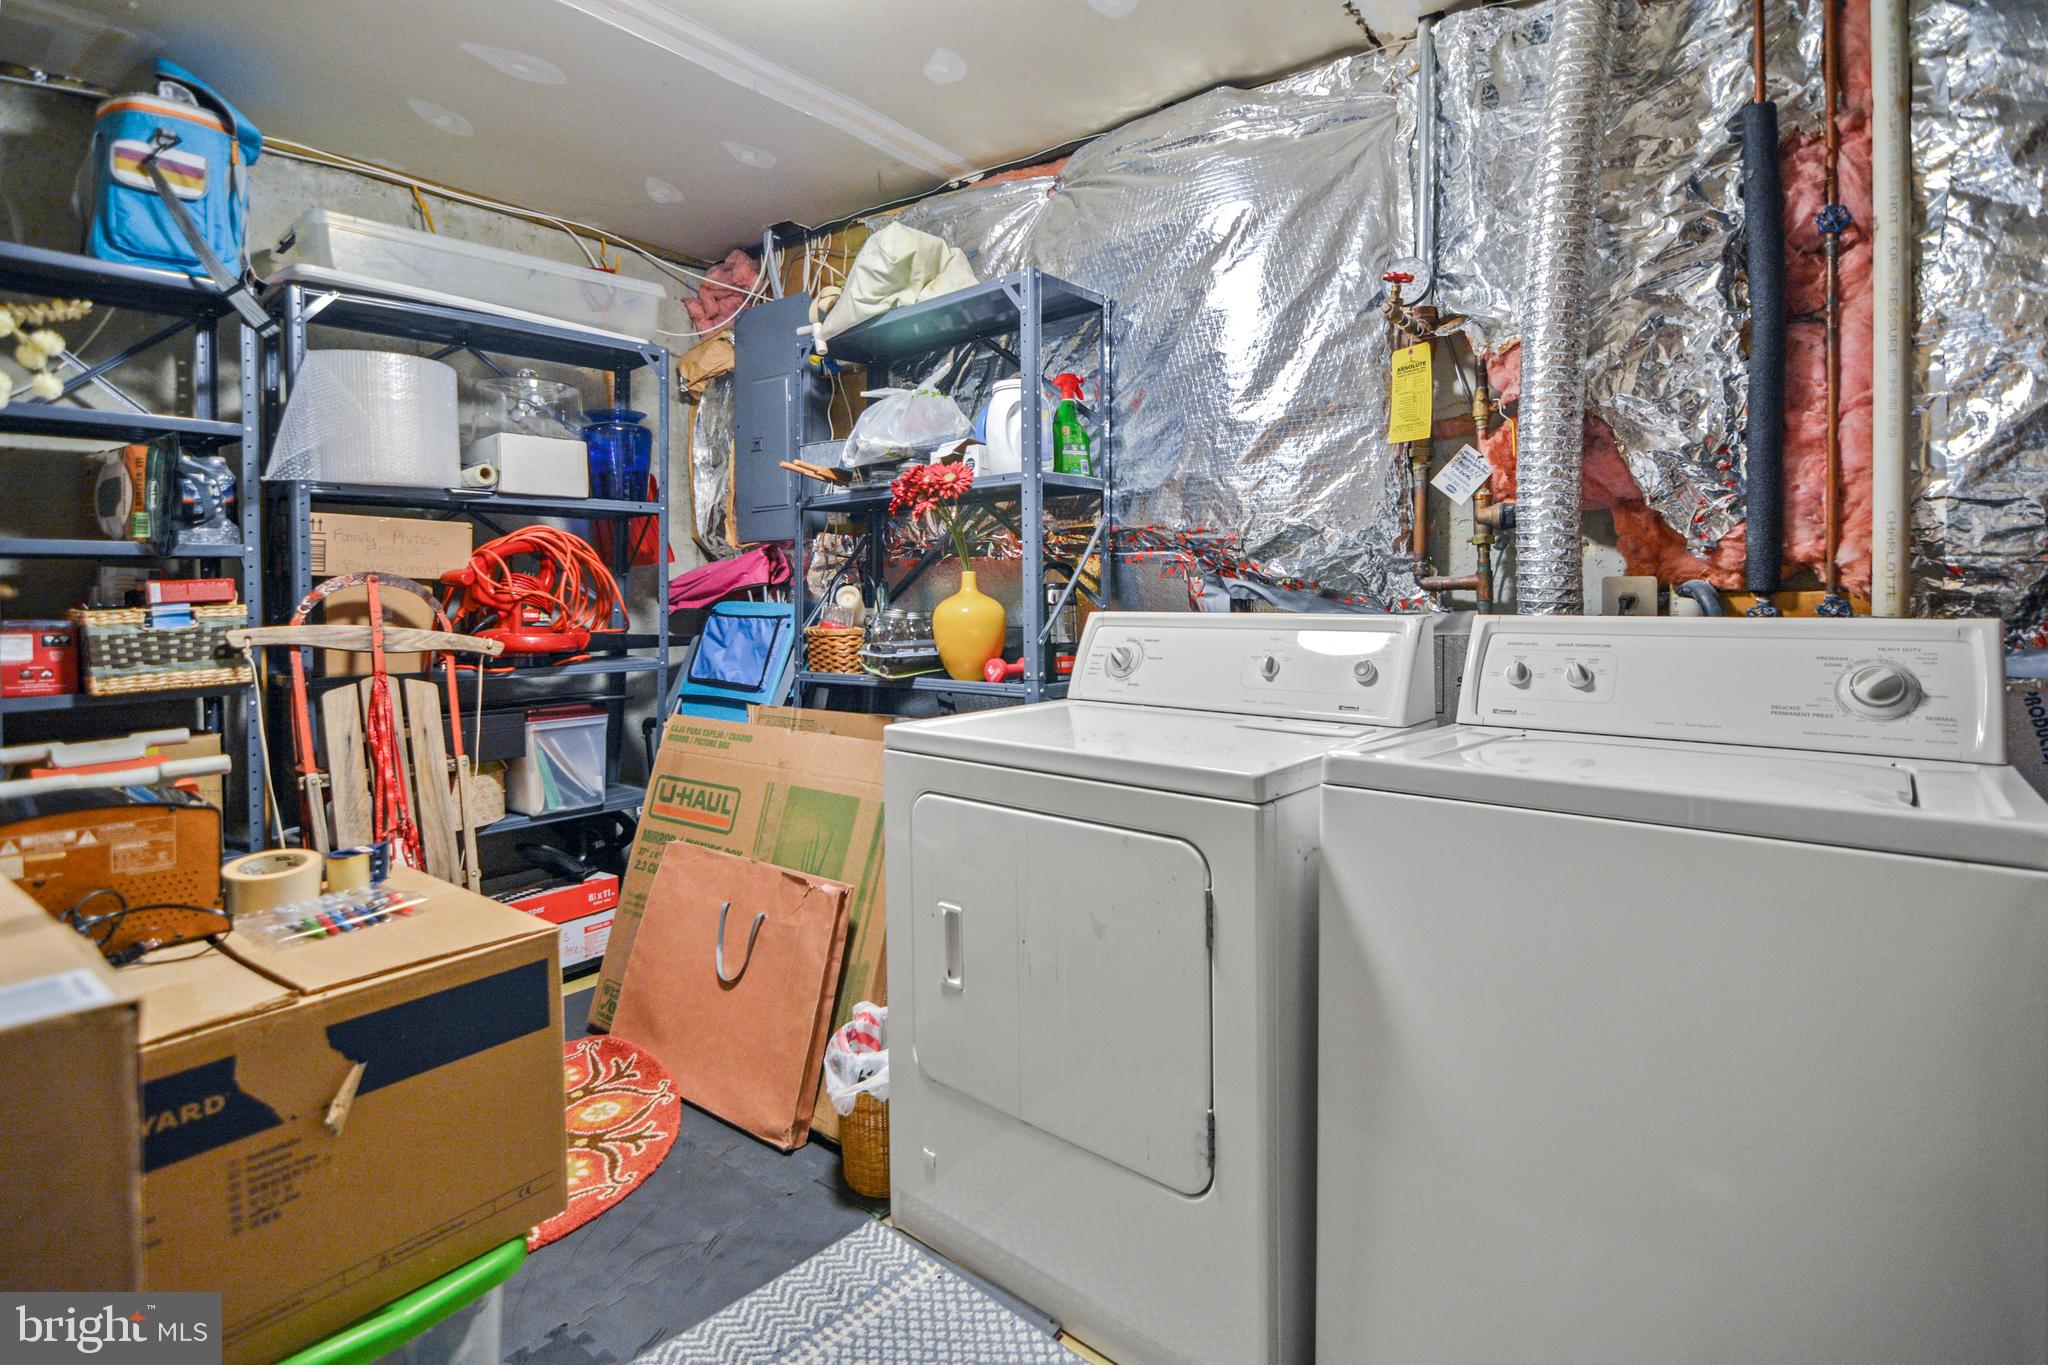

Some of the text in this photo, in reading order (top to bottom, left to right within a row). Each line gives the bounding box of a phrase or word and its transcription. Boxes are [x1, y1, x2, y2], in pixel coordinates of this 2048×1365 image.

[1888, 195, 1899, 225] NOT
[1888, 278, 1899, 358] PRESSURE
[1396, 360, 1427, 373] ABSOLUTE
[334, 529, 377, 549] Family
[1886, 510, 1897, 603] CHARLOTTE
[1770, 710, 1810, 718] PERMANENT
[658, 782, 732, 816] U-HAUL
